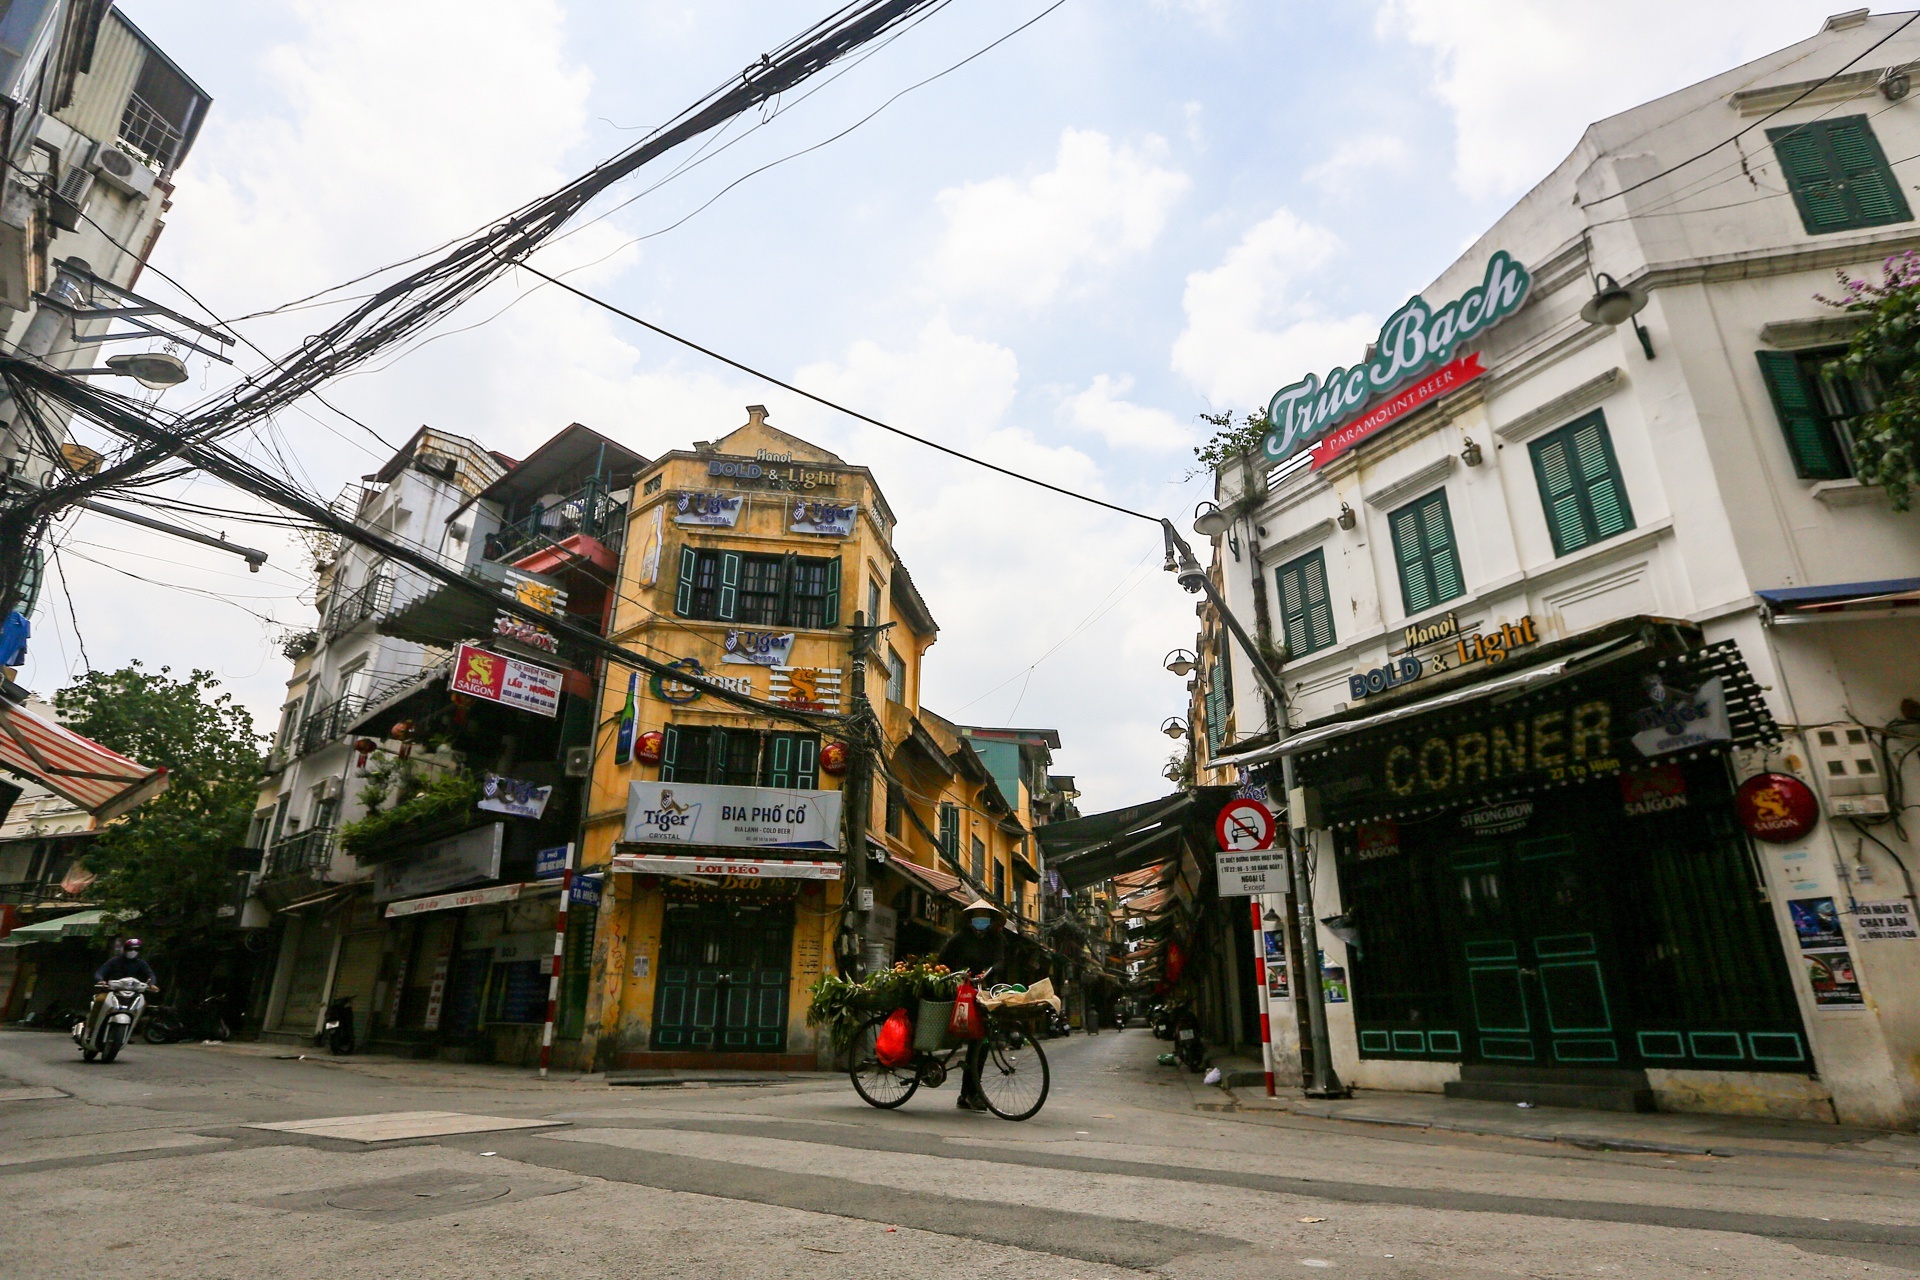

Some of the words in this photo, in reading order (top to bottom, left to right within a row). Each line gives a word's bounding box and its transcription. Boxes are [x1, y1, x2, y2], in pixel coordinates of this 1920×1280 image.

[1267, 365, 1365, 455] Trúc
[1370, 258, 1522, 386] Bạch
[1329, 391, 1416, 451] PARAMOUNT
[1418, 369, 1455, 399] BEER
[757, 449, 792, 464] Hanoi
[708, 461, 762, 479] BOLD
[769, 469, 778, 480] &
[788, 468, 836, 489] Light
[696, 493, 739, 514] Tiger
[812, 502, 854, 523] Tiger
[700, 515, 731, 525] CRYSTAL
[814, 525, 846, 534] CRYSTAL
[1405, 613, 1457, 647] Hanoi
[744, 631, 790, 653] Tiger
[1348, 656, 1422, 700] BOLD
[1432, 653, 1449, 673] &
[1456, 615, 1537, 665] Light
[457, 680, 495, 697] SAIGON
[471, 678, 483, 686] BIA
[1386, 702, 1612, 796] CORNER
[1549, 767, 1565, 780] 27
[721, 806, 747, 822] BIA
[752, 804, 785, 823] PHỐ
[786, 804, 807, 824] CỔ
[1460, 801, 1534, 827] STRONGBOW
[1624, 794, 1688, 817] SAIGON
[643, 810, 690, 832] Tiger
[1753, 817, 1799, 830] SAIGON
[1359, 844, 1400, 860] SAIGON
[727, 864, 759, 874] BÉO
[1241, 874, 1258, 883] NGOẠI
[1244, 884, 1266, 892] Except
[1859, 918, 1884, 930] CHẠY
[1885, 916, 1908, 927] BÀN
